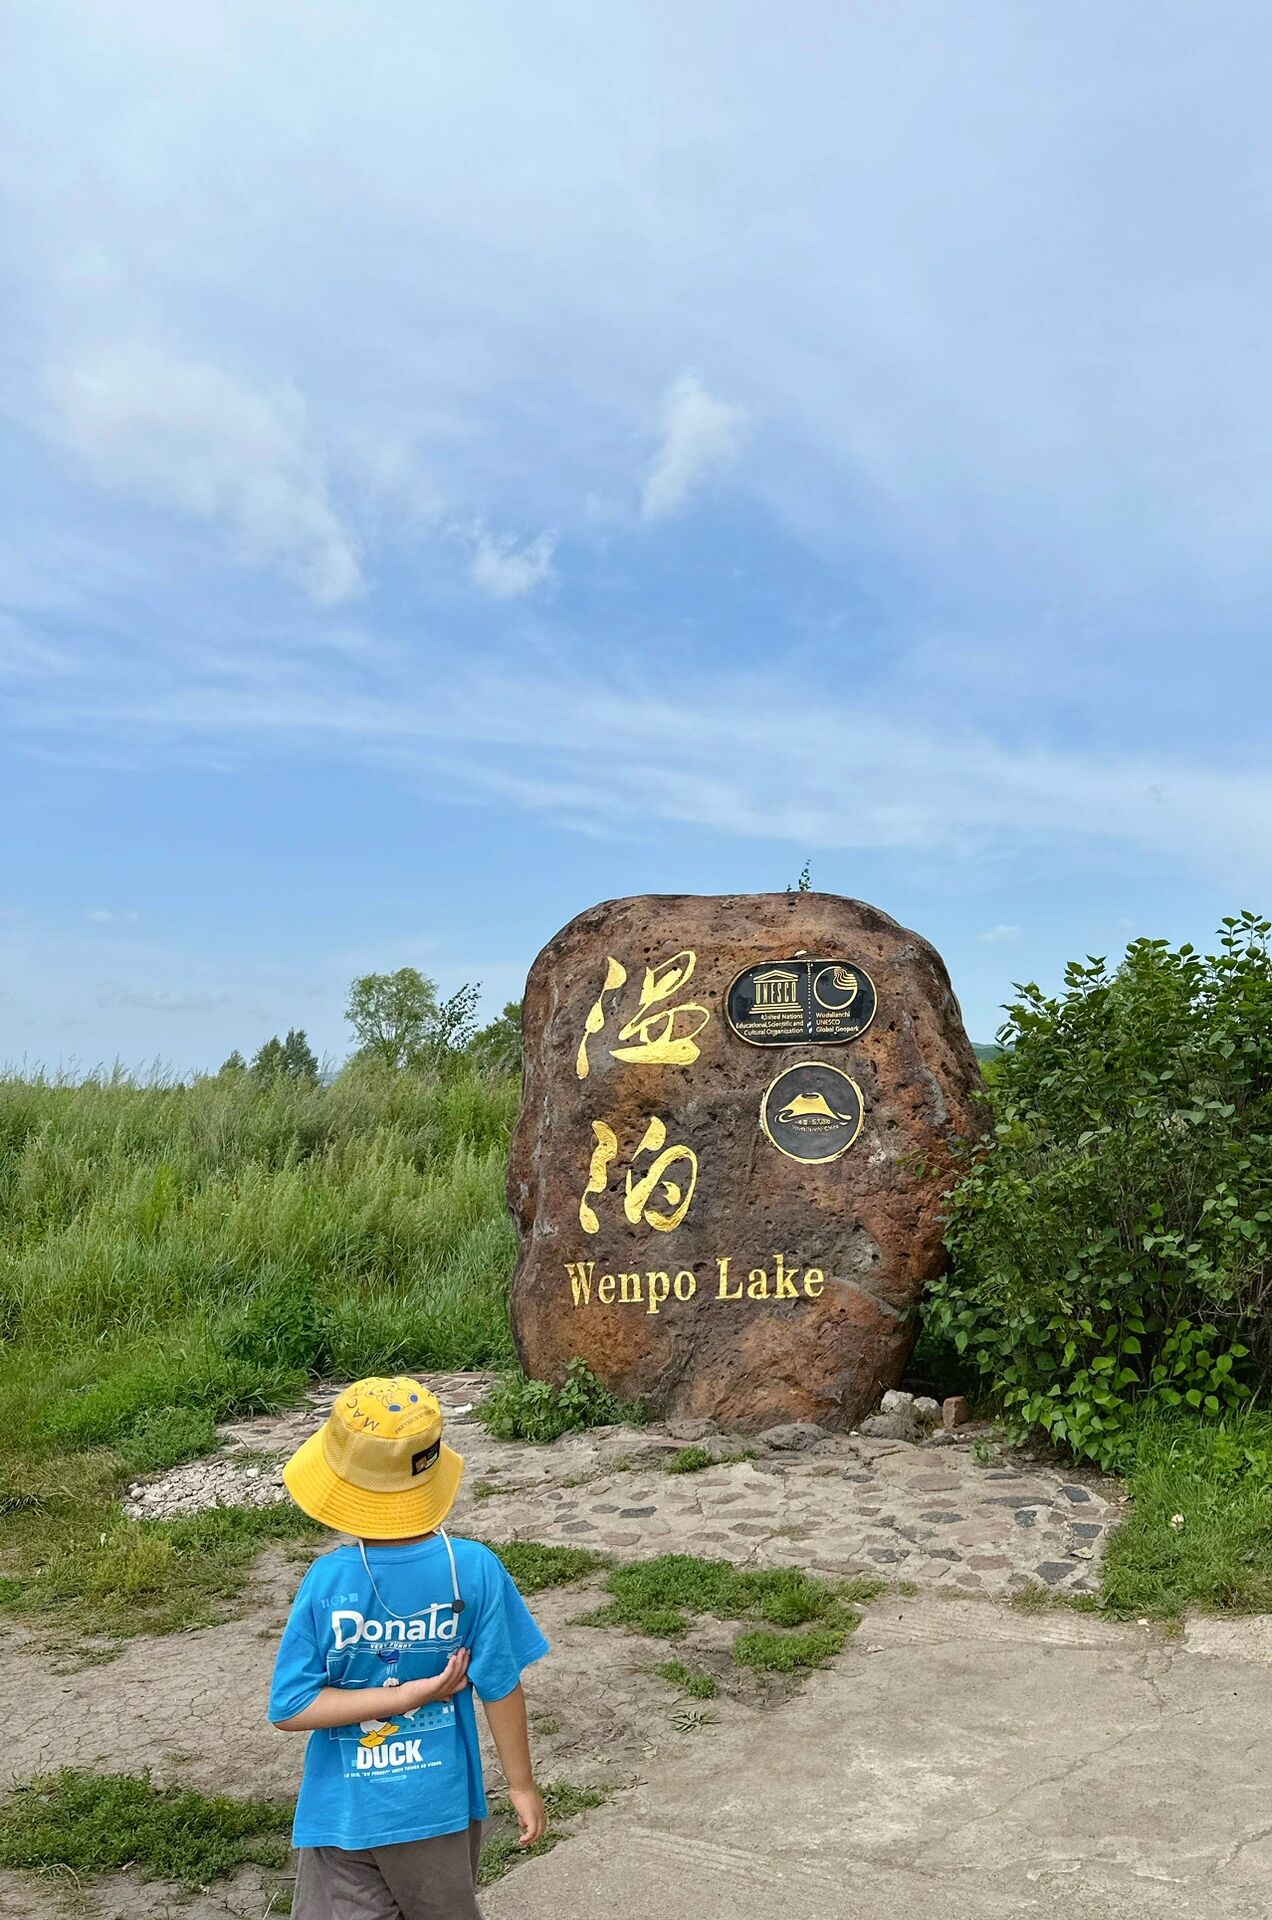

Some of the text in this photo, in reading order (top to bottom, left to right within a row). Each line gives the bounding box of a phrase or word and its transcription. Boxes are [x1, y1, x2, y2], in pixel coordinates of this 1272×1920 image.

[755, 981, 797, 1004] UNESCO
[815, 1018, 841, 1026] UNESCO
[815, 1025, 859, 1033] Global Geopark
[743, 1028, 804, 1037] Cultural Organization
[564, 1254, 825, 1314] Wenpo Lake
[331, 1603, 459, 1650] Donald
[389, 1641, 413, 1649] FUNNY
[356, 1739, 424, 1770] DUCK
